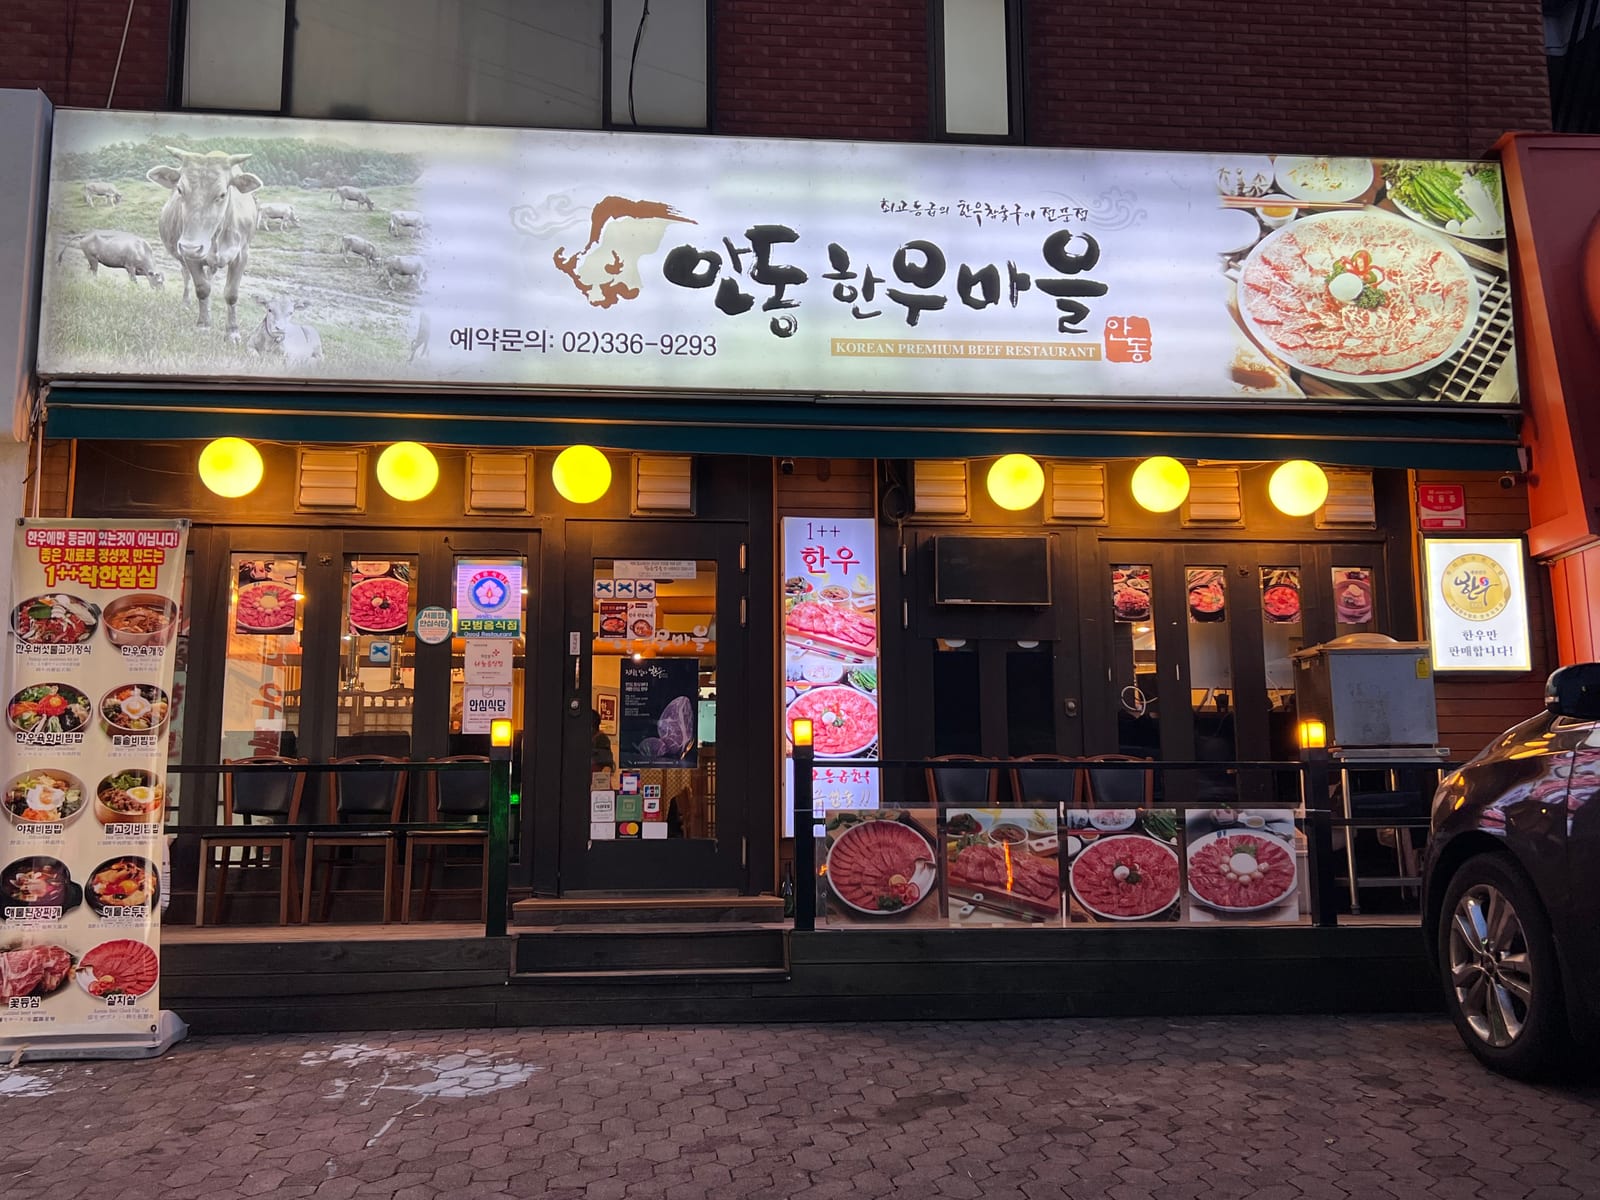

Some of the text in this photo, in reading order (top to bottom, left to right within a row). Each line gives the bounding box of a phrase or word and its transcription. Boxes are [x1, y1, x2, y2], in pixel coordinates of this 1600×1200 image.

[1040, 206, 1089, 222] 전문점
[450, 327, 717, 356] 예약문의: 02)336-9293
[836, 341, 1095, 358] KOREAN PREMIUM BEEF RESTAURANT
[27, 530, 65, 546] 한우에만
[68, 531, 96, 547] 등급이
[138, 532, 178, 547] 아닙니다!
[41, 548, 164, 563] 좋은 재료로 정성껏 만드는
[800, 545, 860, 575] 한우
[461, 620, 517, 631] 모범음식점
[1463, 630, 1497, 641] 한우만
[1449, 646, 1513, 657] 판매합니다!
[469, 699, 506, 712] 안심식당
[10, 997, 41, 1009] 꽃등심
[107, 995, 137, 1006] 살치살
